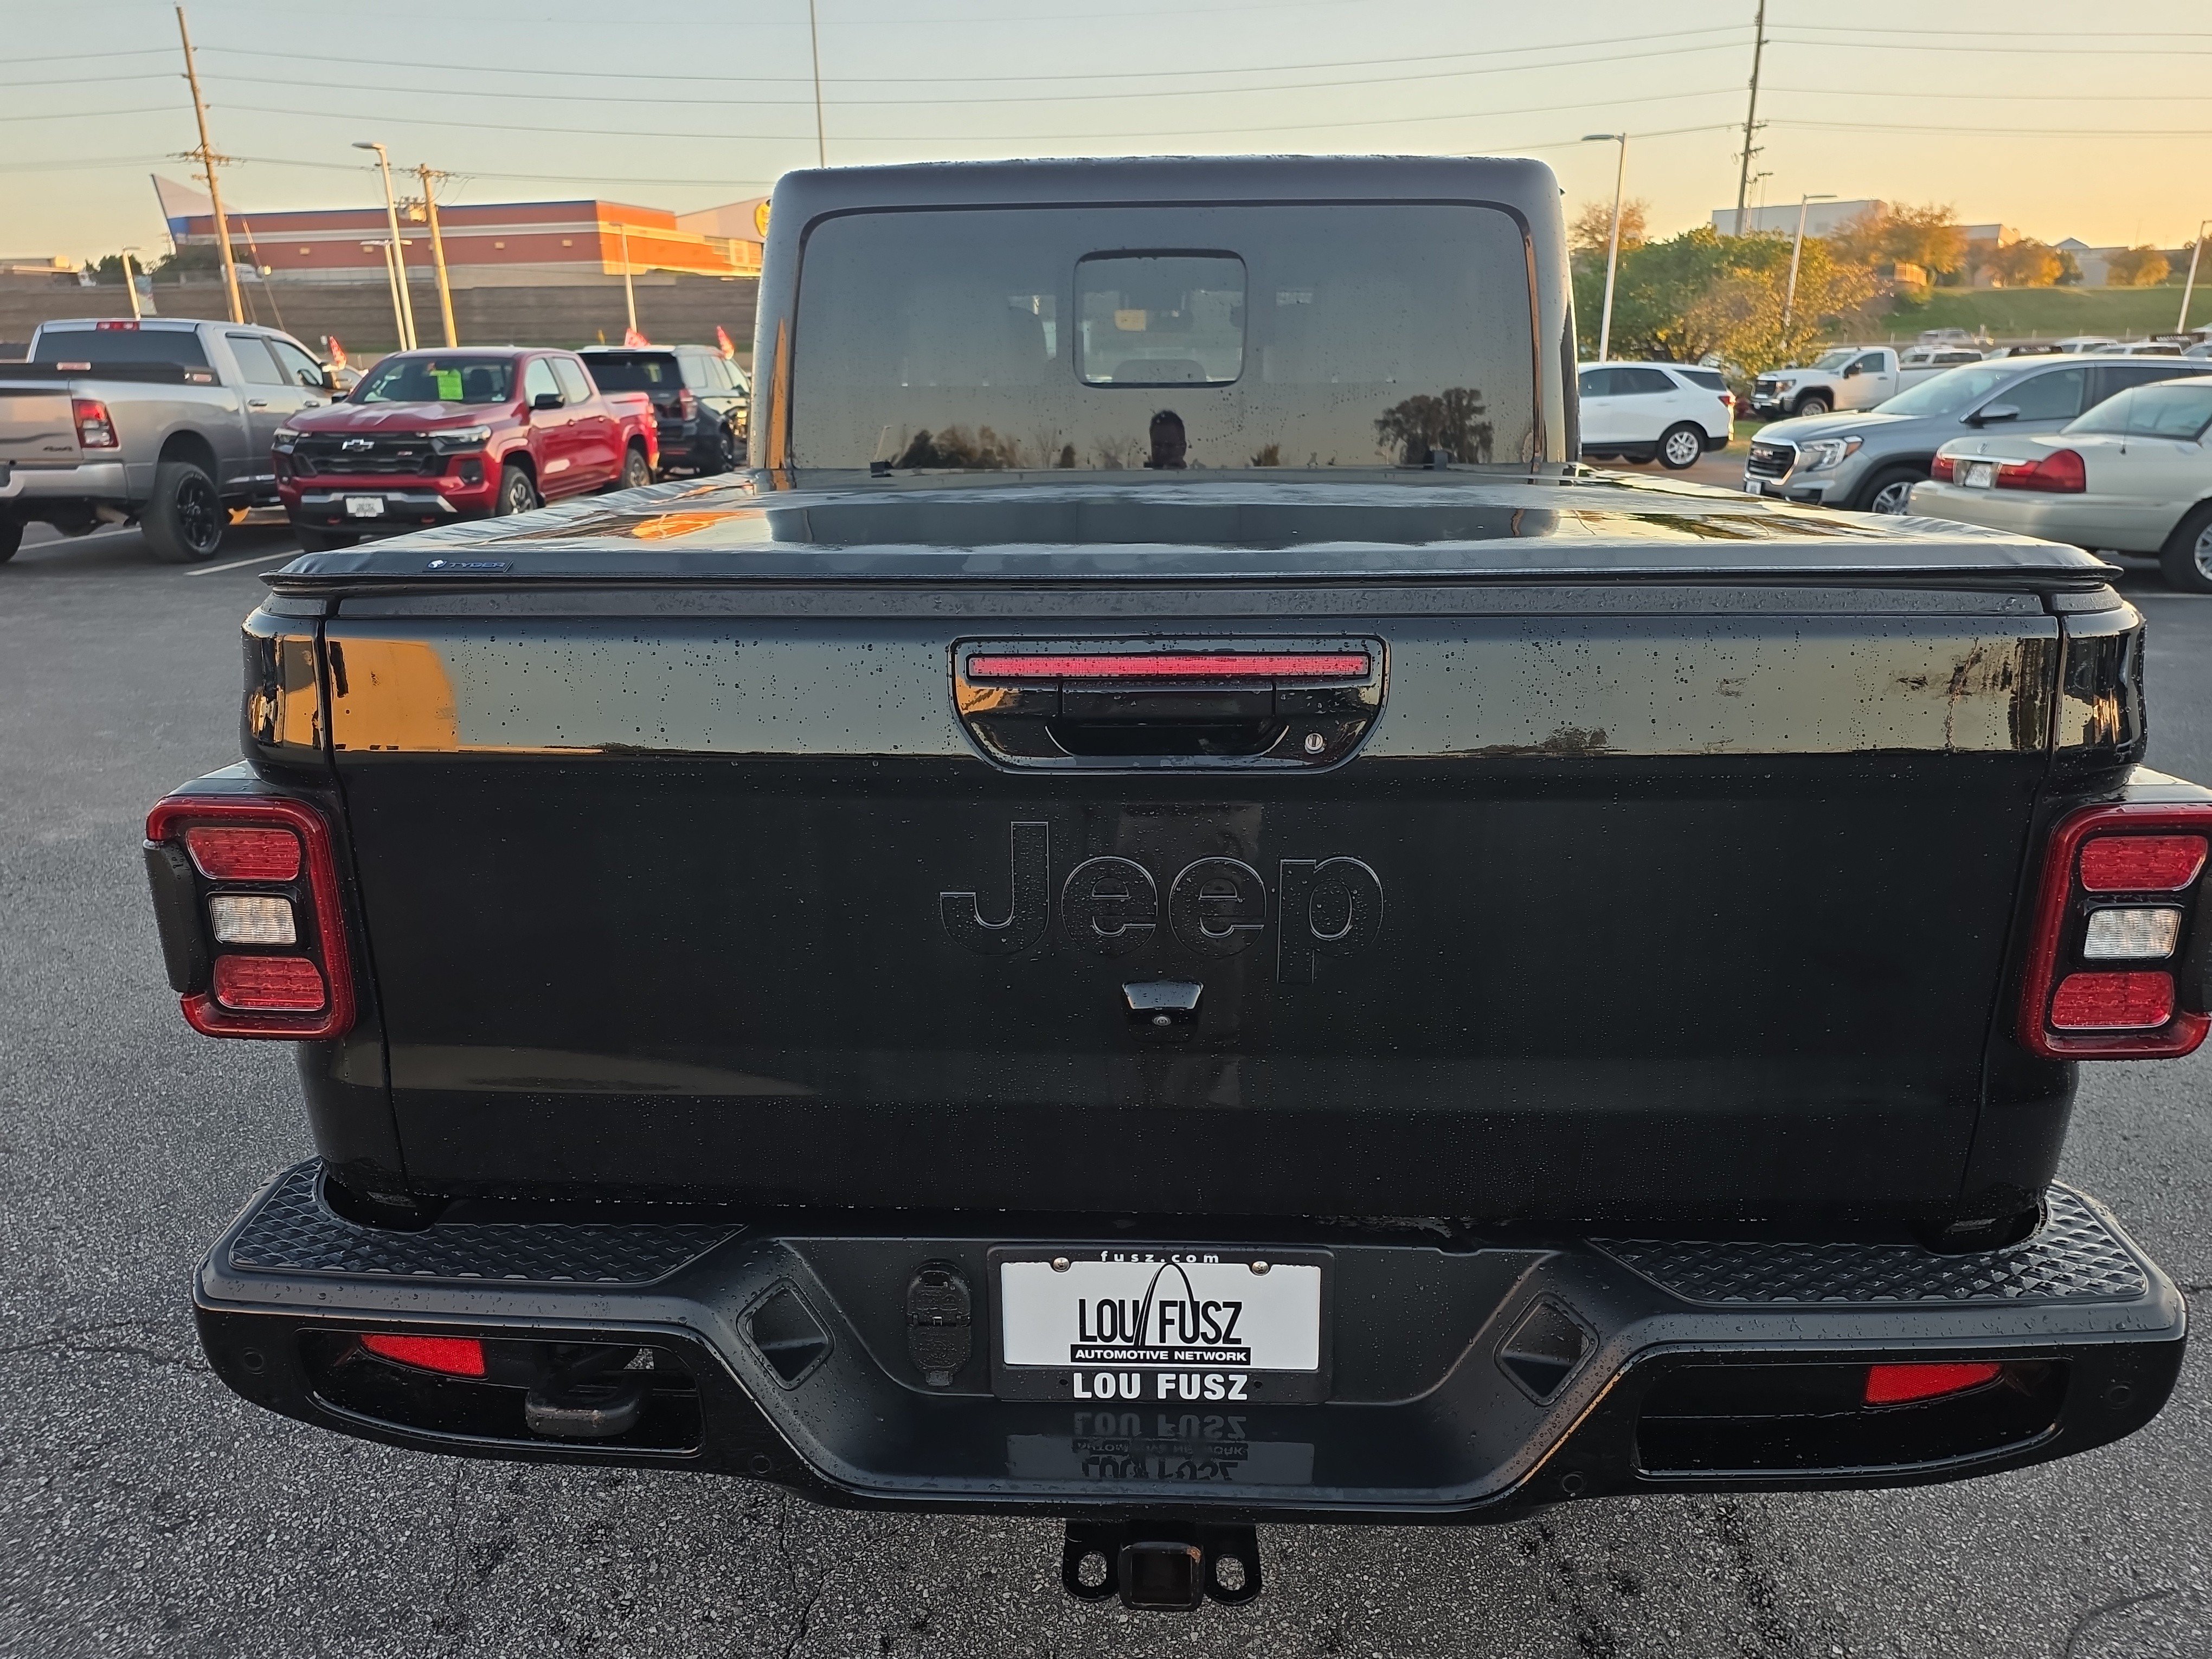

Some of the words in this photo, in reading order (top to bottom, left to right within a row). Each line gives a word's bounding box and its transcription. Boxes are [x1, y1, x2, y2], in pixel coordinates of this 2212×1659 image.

[940, 820, 1385, 984] Jeep
[1101, 1250, 1219, 1263] fusz.com
[1078, 1298, 1140, 1343] LOU
[1159, 1300, 1243, 1345] FUSZ
[1075, 1349, 1169, 1360] AUTOMOTIVE
[1174, 1351, 1247, 1361] NETWORK
[1073, 1372, 1141, 1399] LOU
[1157, 1373, 1248, 1400] FUSZ
